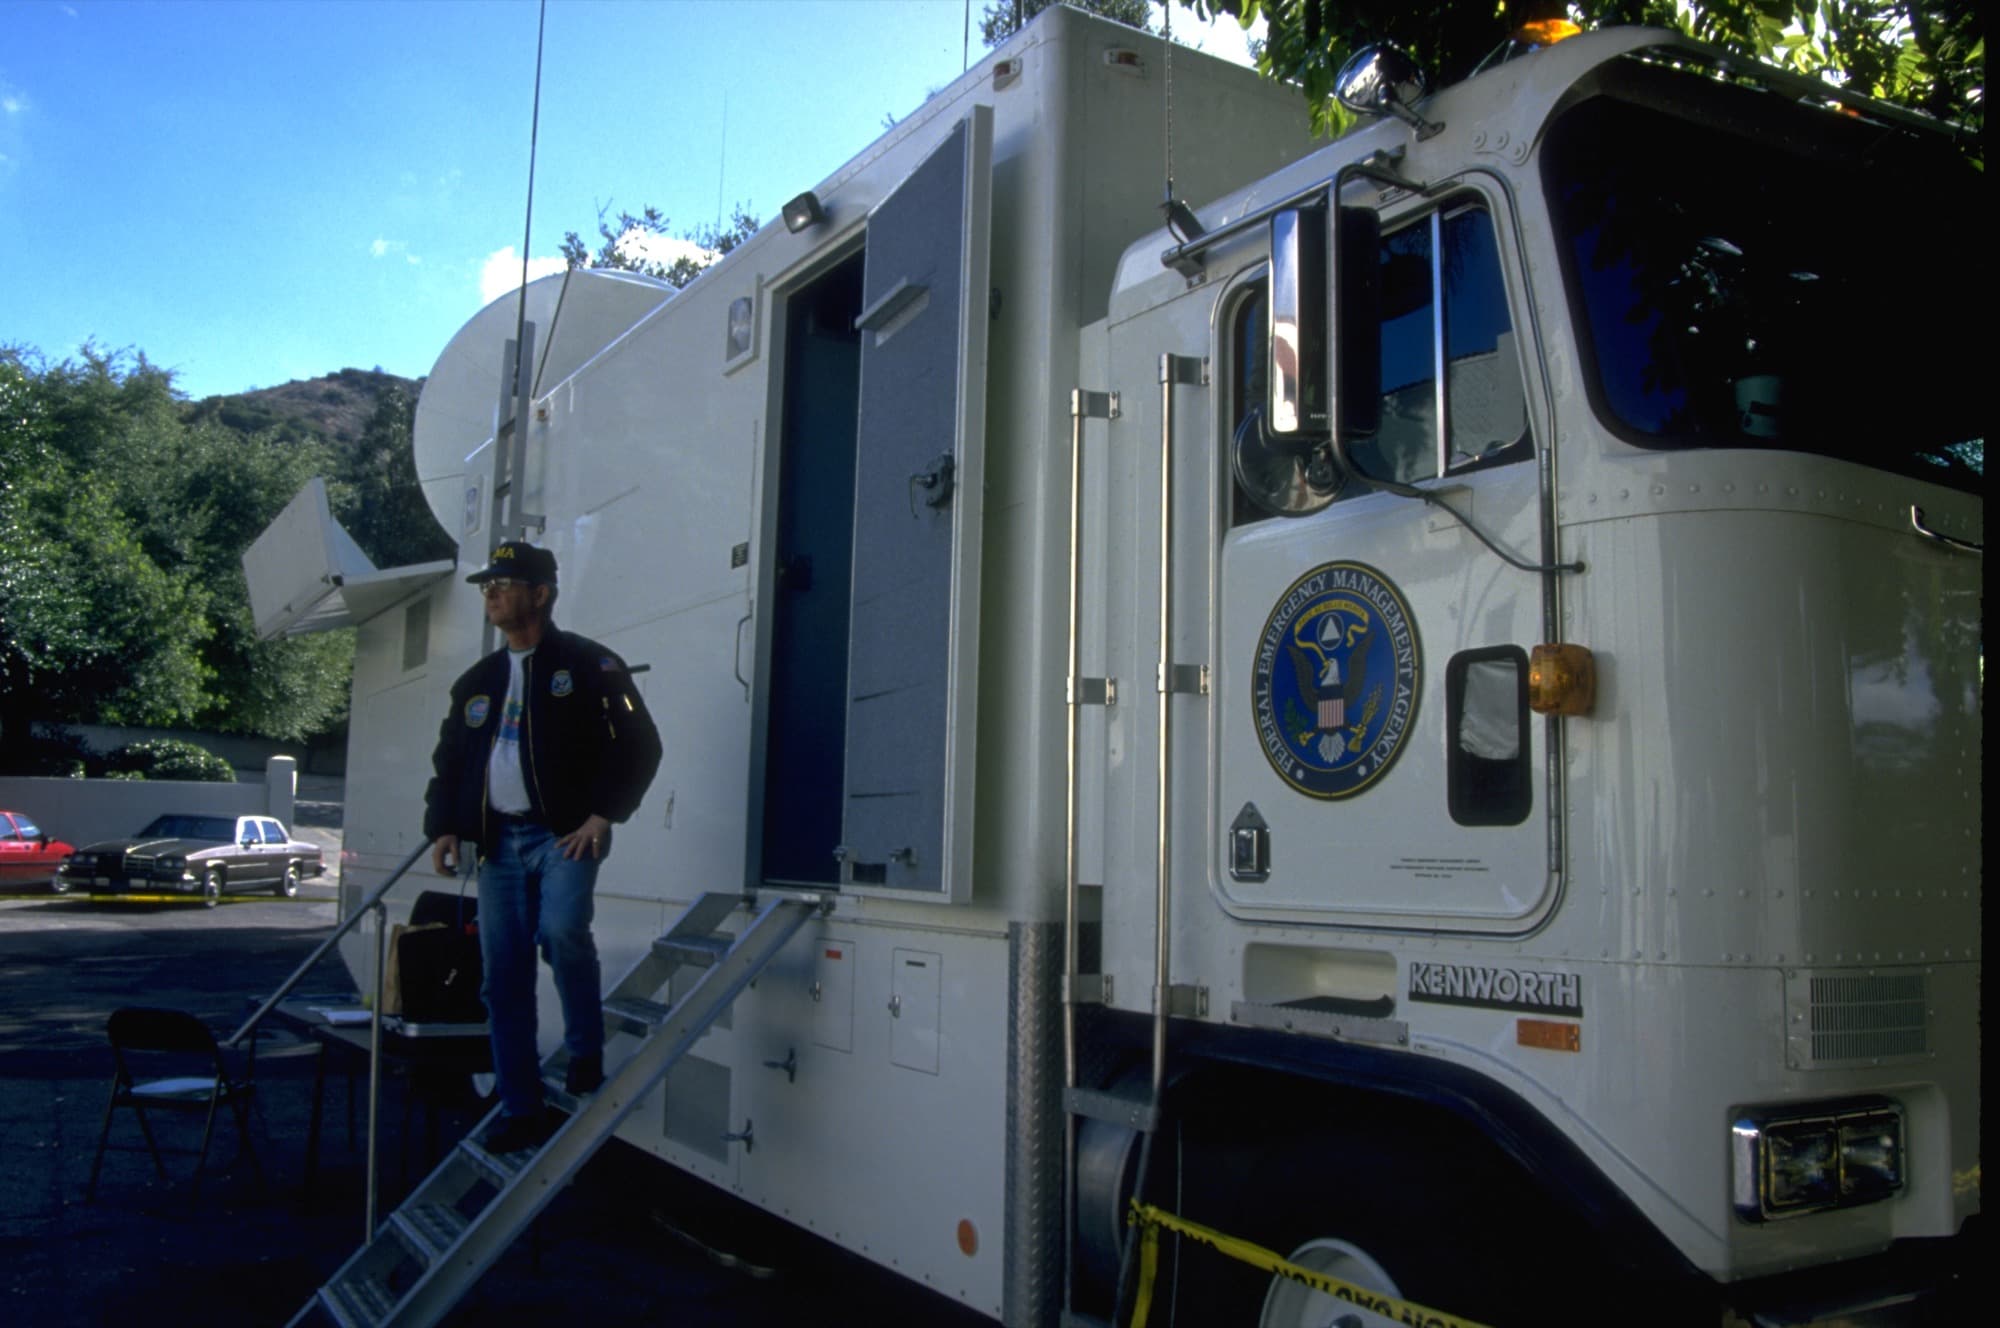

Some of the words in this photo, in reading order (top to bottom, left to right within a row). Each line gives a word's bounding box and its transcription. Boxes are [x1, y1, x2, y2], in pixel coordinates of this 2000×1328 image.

[1258, 573, 1327, 675] EMERGENCY
[1333, 570, 1413, 679] MANAGEMENT
[1257, 682, 1295, 774] FEDERAL
[1370, 683, 1411, 768] AGENCY
[1410, 961, 1581, 1009] KENWORTH
